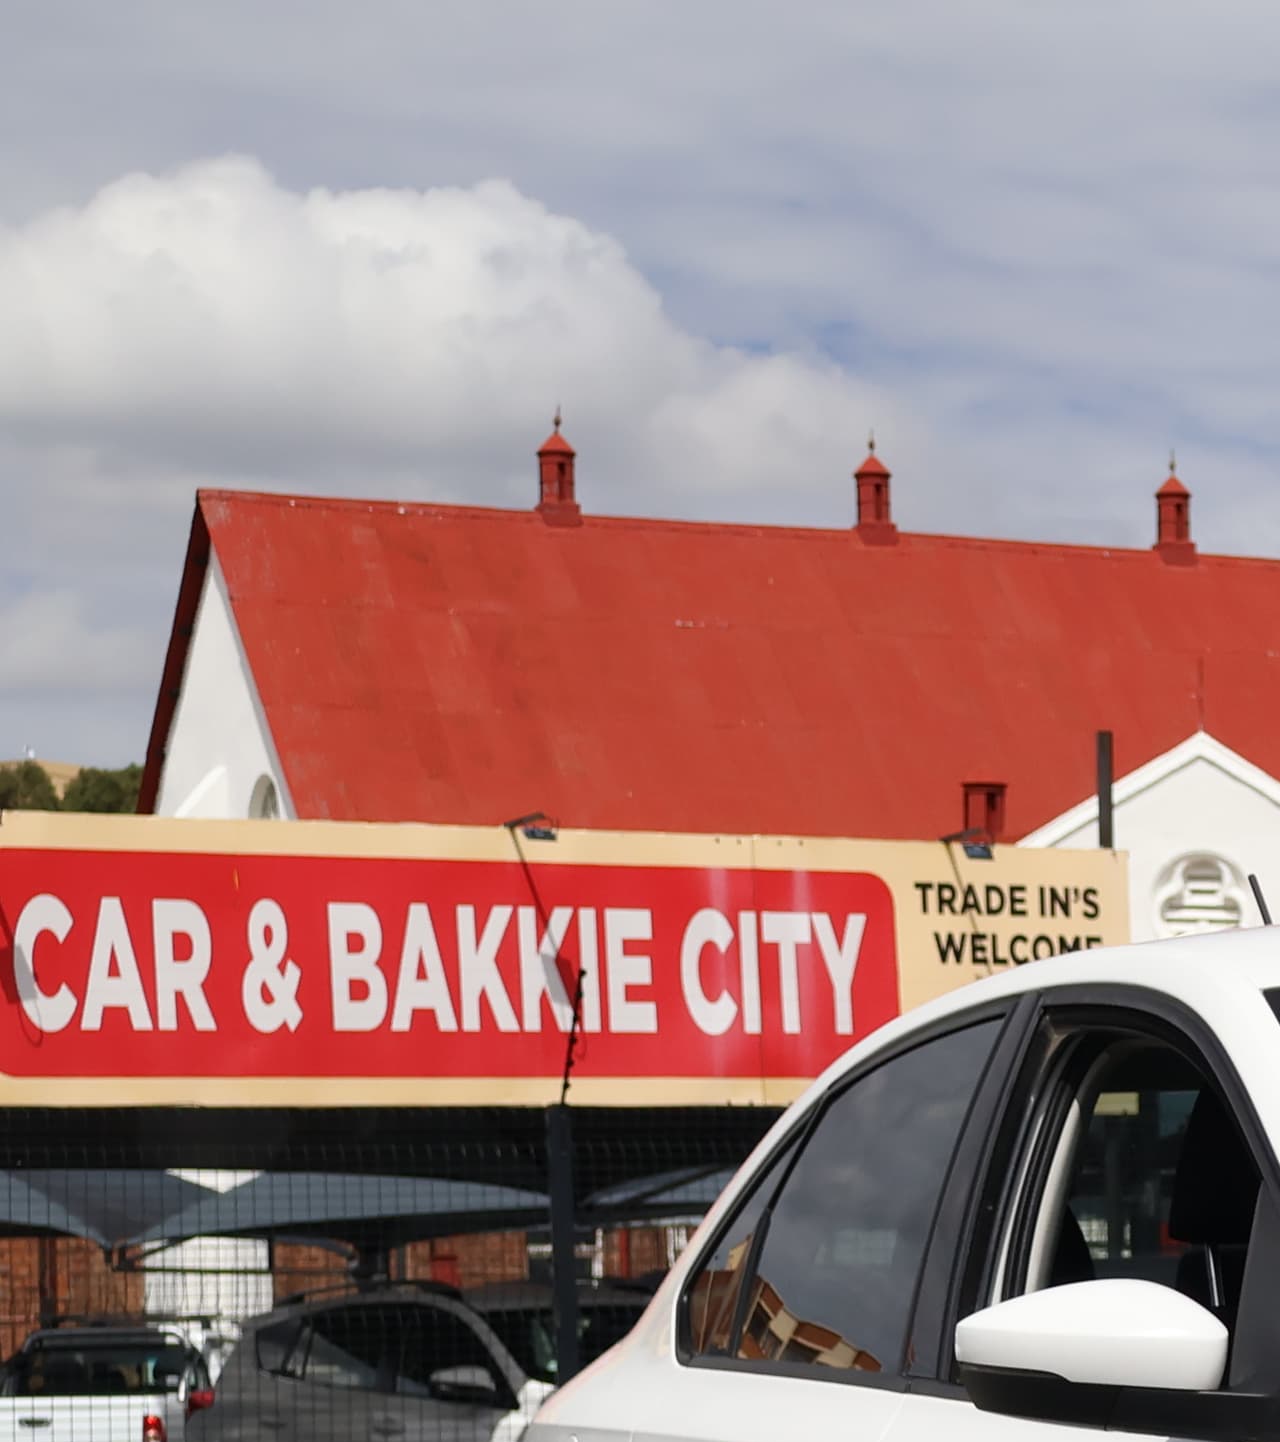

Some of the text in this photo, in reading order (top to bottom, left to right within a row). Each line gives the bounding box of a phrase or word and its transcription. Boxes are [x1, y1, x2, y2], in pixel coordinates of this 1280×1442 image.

[915, 882, 1100, 920] TRADE IN'S
[14, 893, 867, 1036] CAR & BAKKIE CITY
